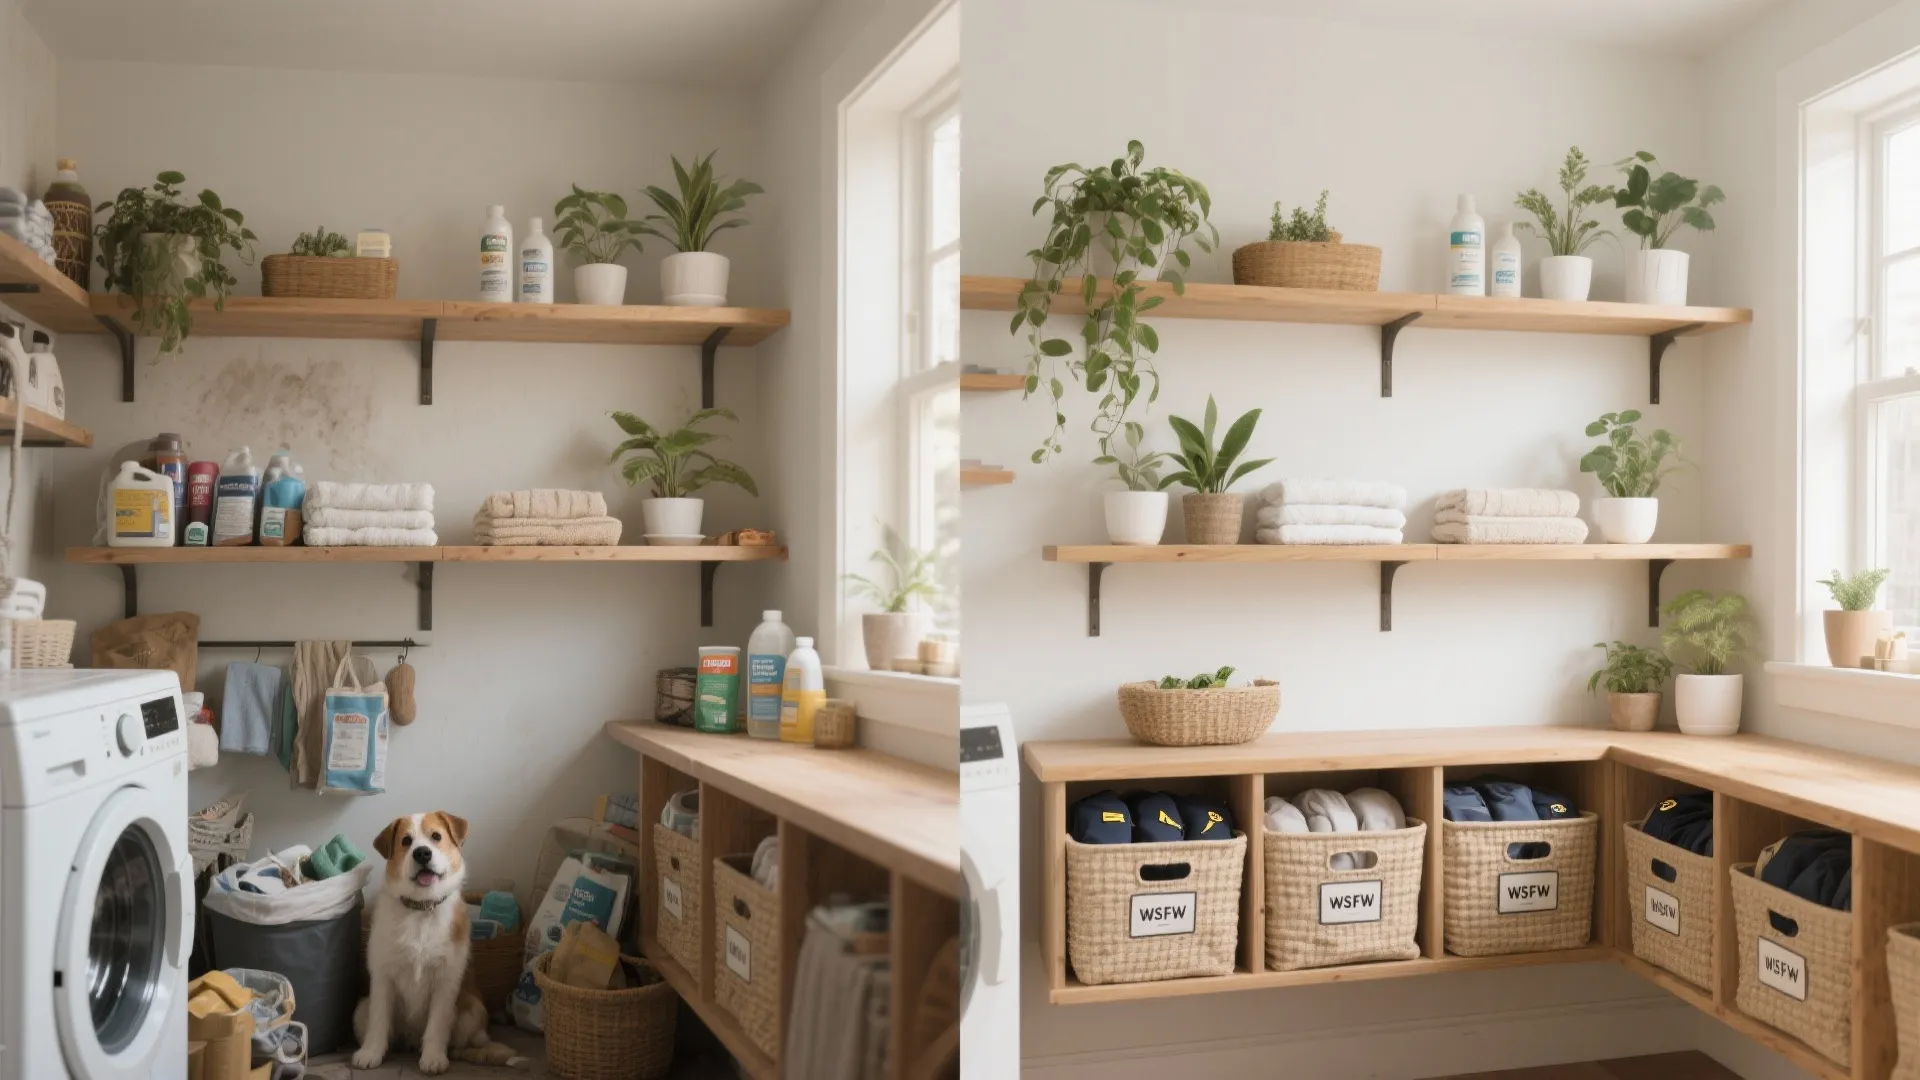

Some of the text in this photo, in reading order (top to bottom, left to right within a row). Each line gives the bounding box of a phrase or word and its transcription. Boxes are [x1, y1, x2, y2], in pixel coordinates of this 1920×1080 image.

[1507, 884, 1550, 900] WSFW
[1329, 893, 1374, 909] WSFW
[1139, 905, 1187, 922] WSFW
[1765, 955, 1799, 983] WSFW
